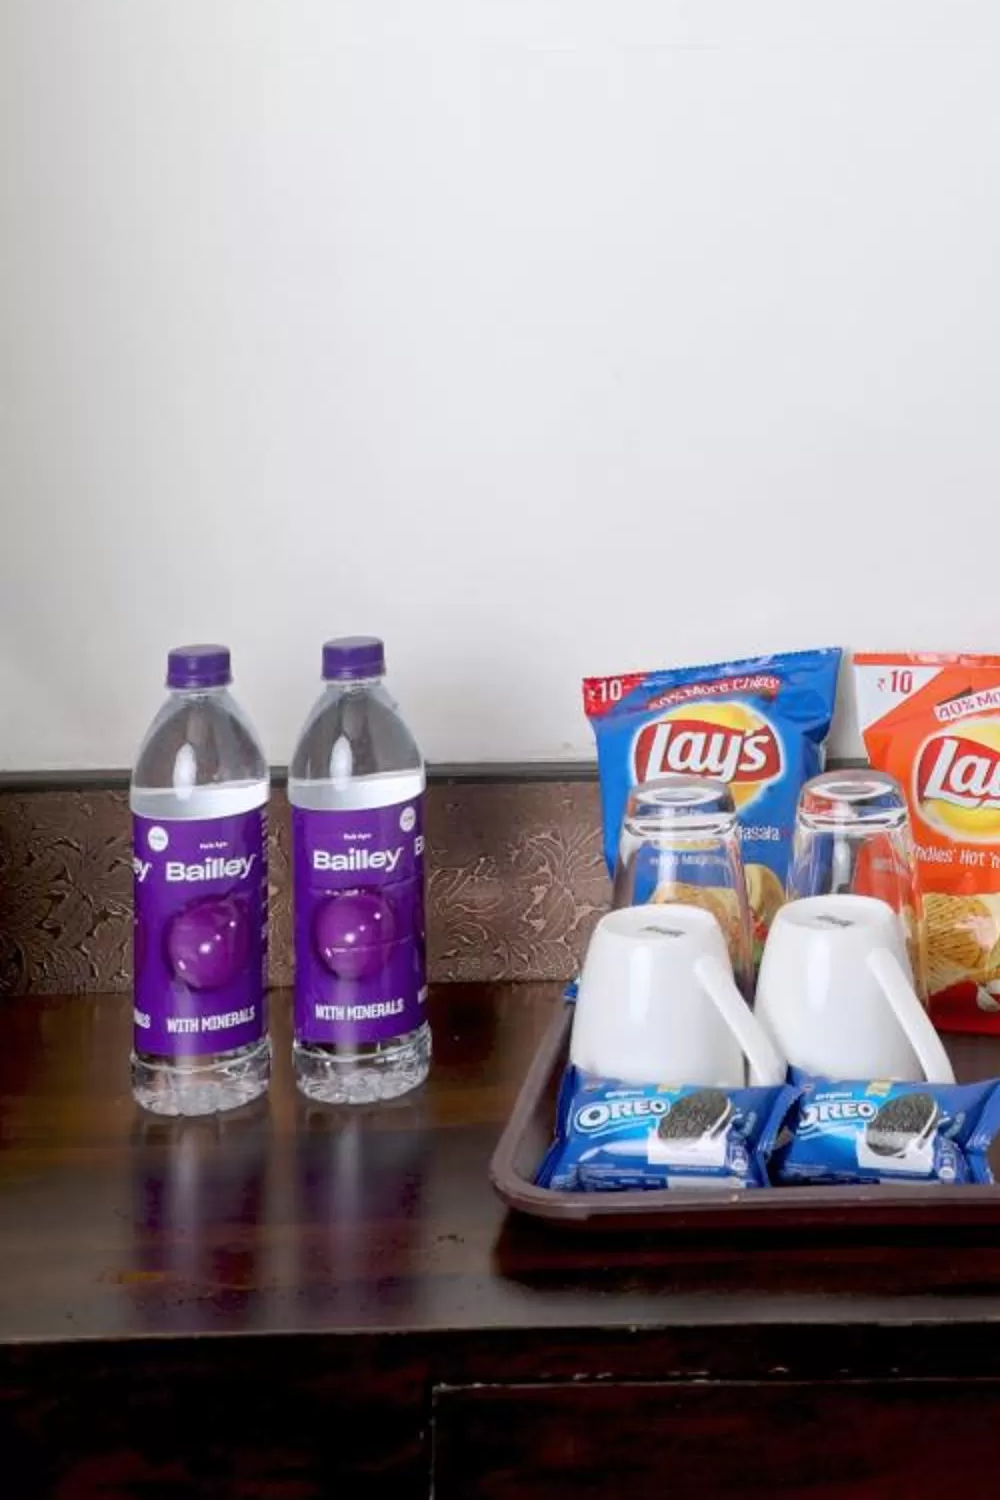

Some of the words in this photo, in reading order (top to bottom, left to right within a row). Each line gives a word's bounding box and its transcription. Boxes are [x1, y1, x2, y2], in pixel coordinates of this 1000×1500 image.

[890, 670, 913, 694] 10
[166, 853, 257, 882] Bailley
[313, 846, 405, 873] Bailley
[167, 1017, 199, 1033] WITH
[201, 1006, 256, 1032] MINERALS
[315, 1003, 345, 1021] WITH
[347, 997, 404, 1020] MINERALS
[578, 1099, 668, 1128] OREO
